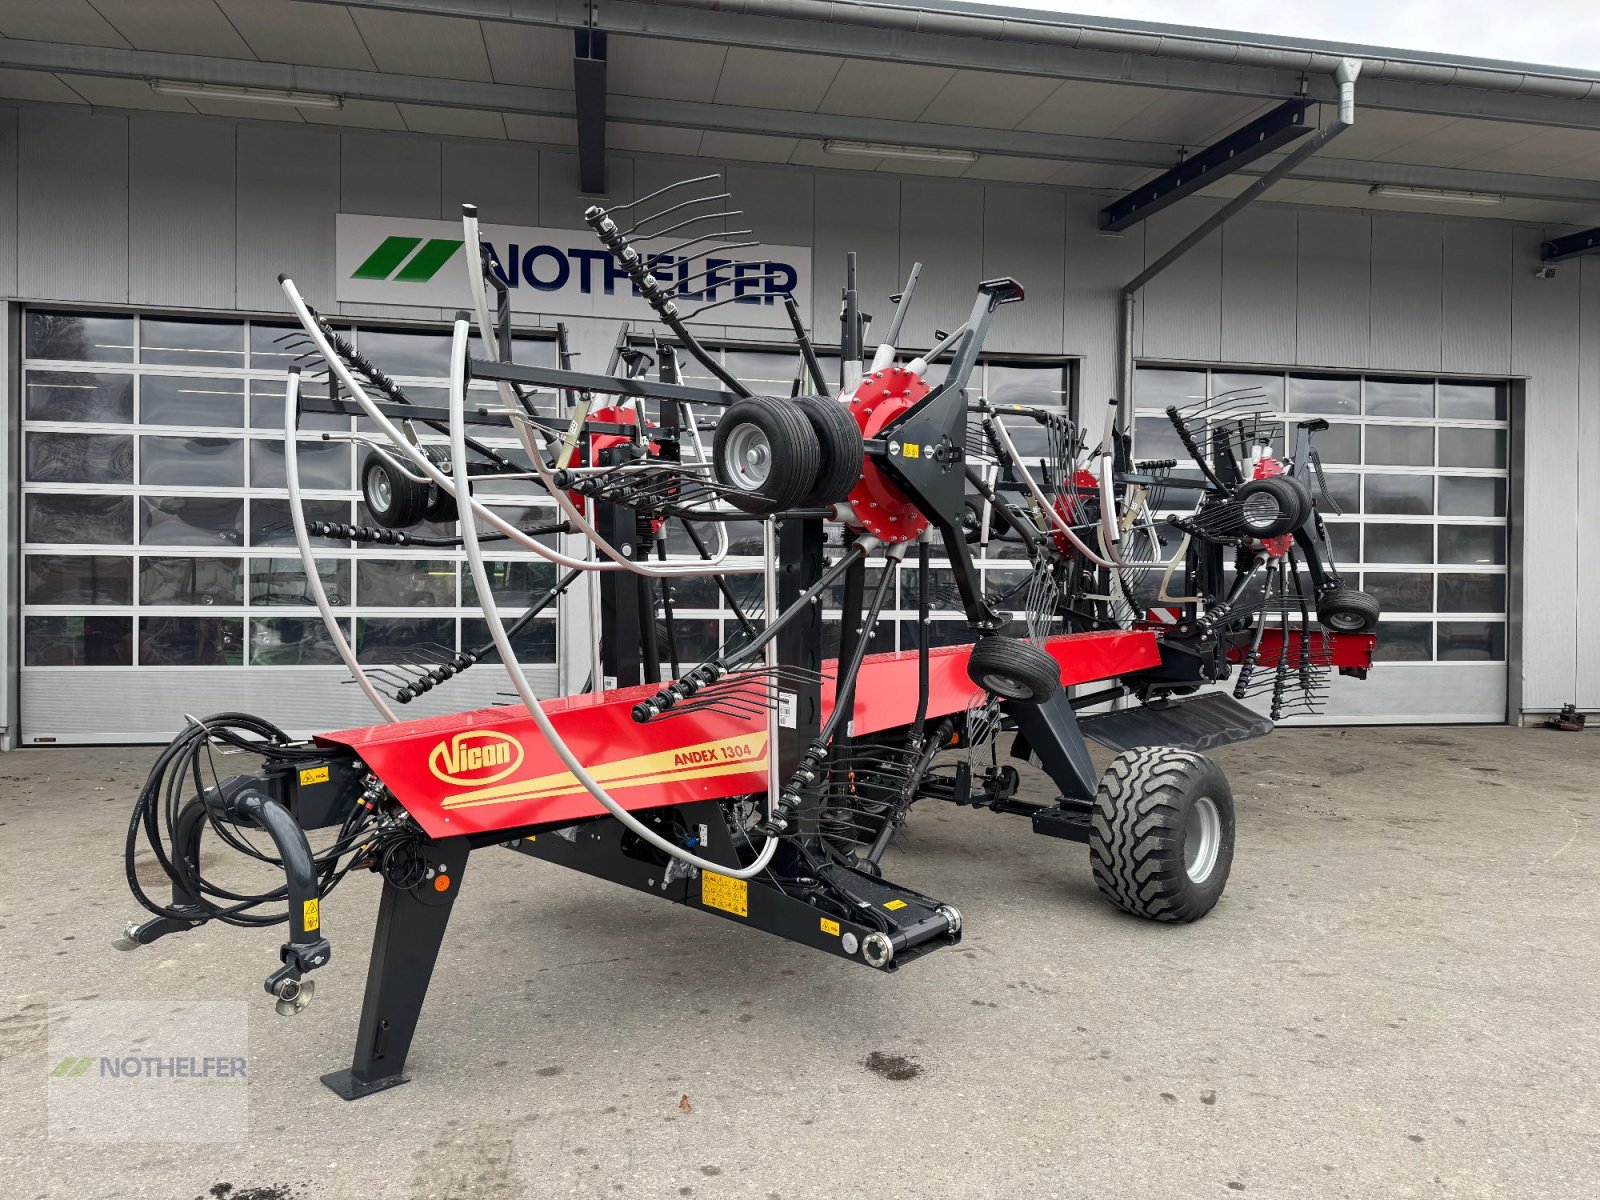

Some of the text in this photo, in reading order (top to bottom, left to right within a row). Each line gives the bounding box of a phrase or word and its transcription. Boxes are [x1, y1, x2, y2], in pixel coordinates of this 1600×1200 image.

[438, 738, 511, 775] Vicon
[674, 744, 752, 766] ANDEX 1304
